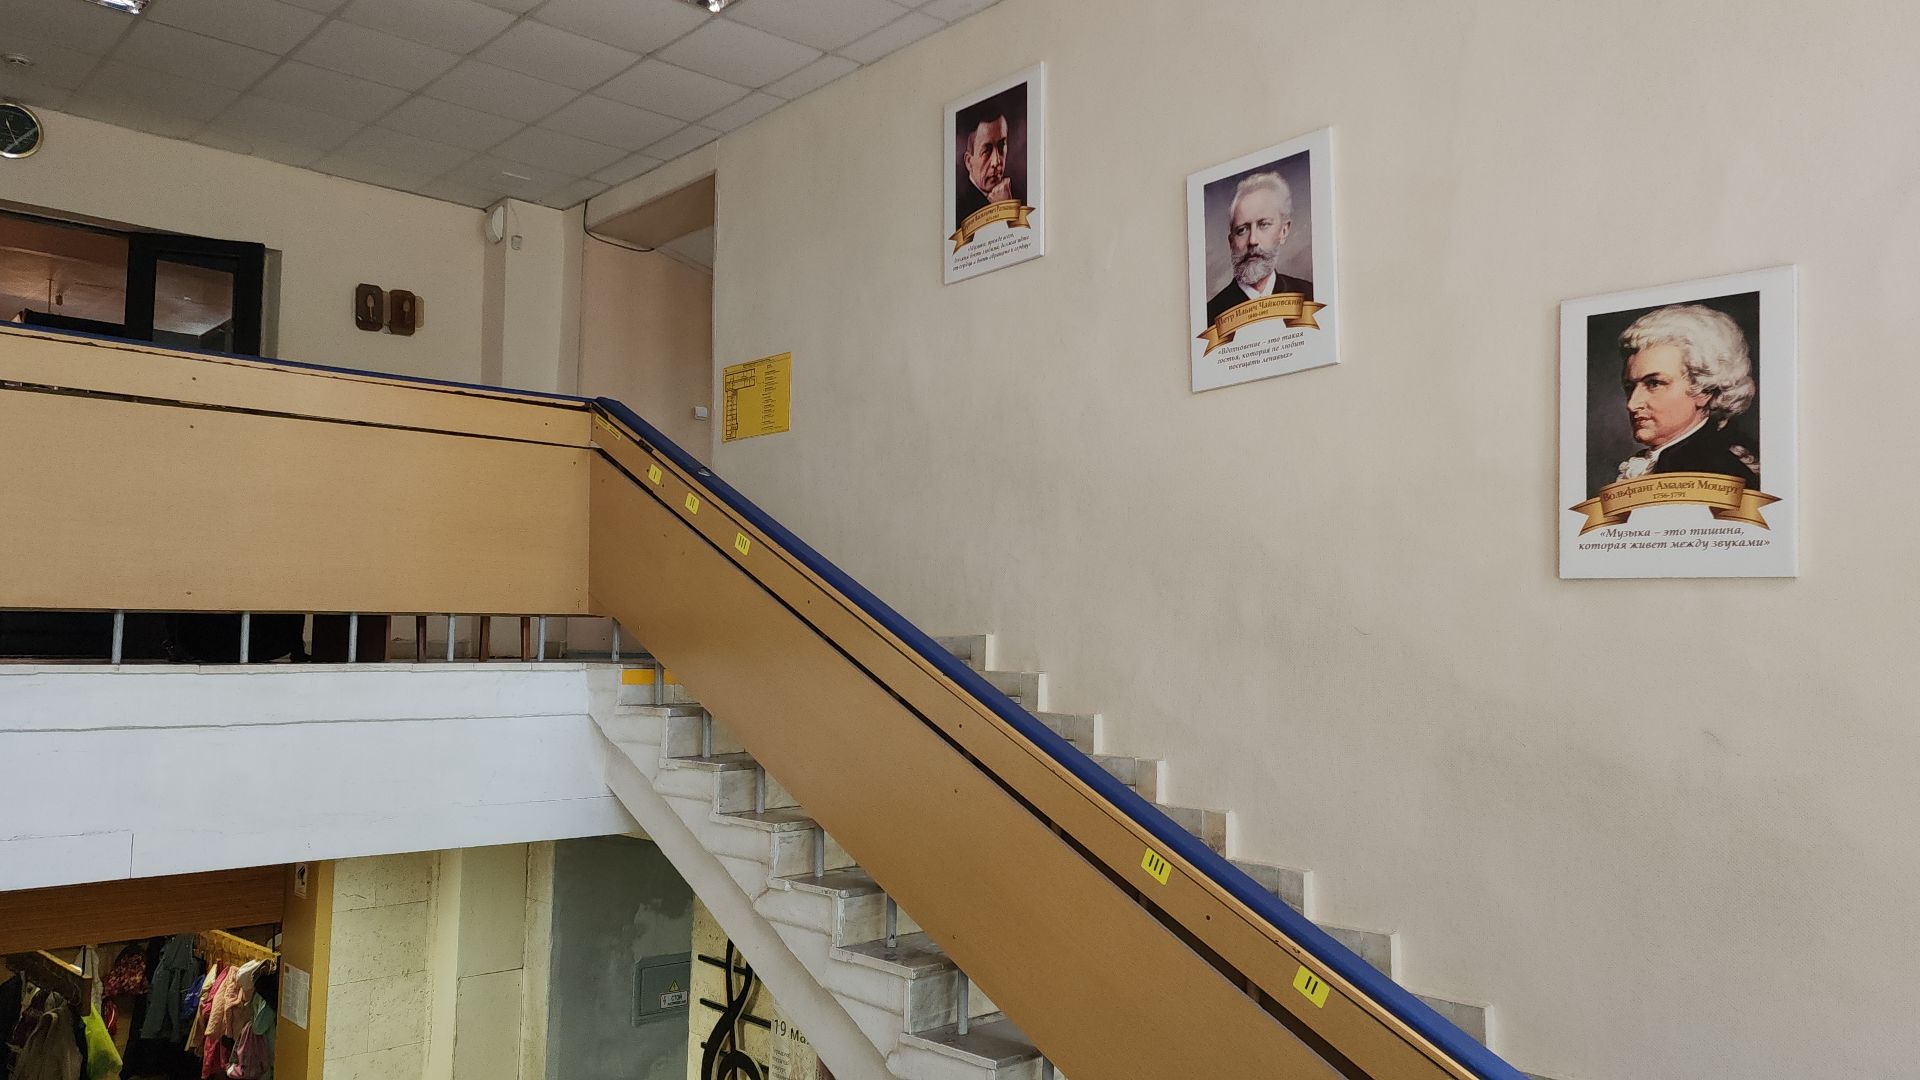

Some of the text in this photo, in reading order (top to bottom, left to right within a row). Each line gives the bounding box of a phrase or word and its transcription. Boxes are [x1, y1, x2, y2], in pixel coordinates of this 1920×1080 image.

[1236, 305, 1258, 317] Ильич
[1260, 299, 1303, 309] Чайковский
[1281, 331, 1304, 342] такая
[1242, 347, 1270, 359] которая
[1271, 345, 1279, 353] не
[1280, 340, 1305, 351] любит
[1228, 359, 1260, 371] посещать
[1603, 479, 1740, 501] Вольфганг Амадей Моцарт
[1653, 491, 1686, 500] 1756-1791
[1600, 528, 1651, 541] «Музыка
[1663, 528, 1687, 537] это
[1689, 526, 1745, 536] тишина,
[1578, 538, 1771, 552] которая живет между звуками»
